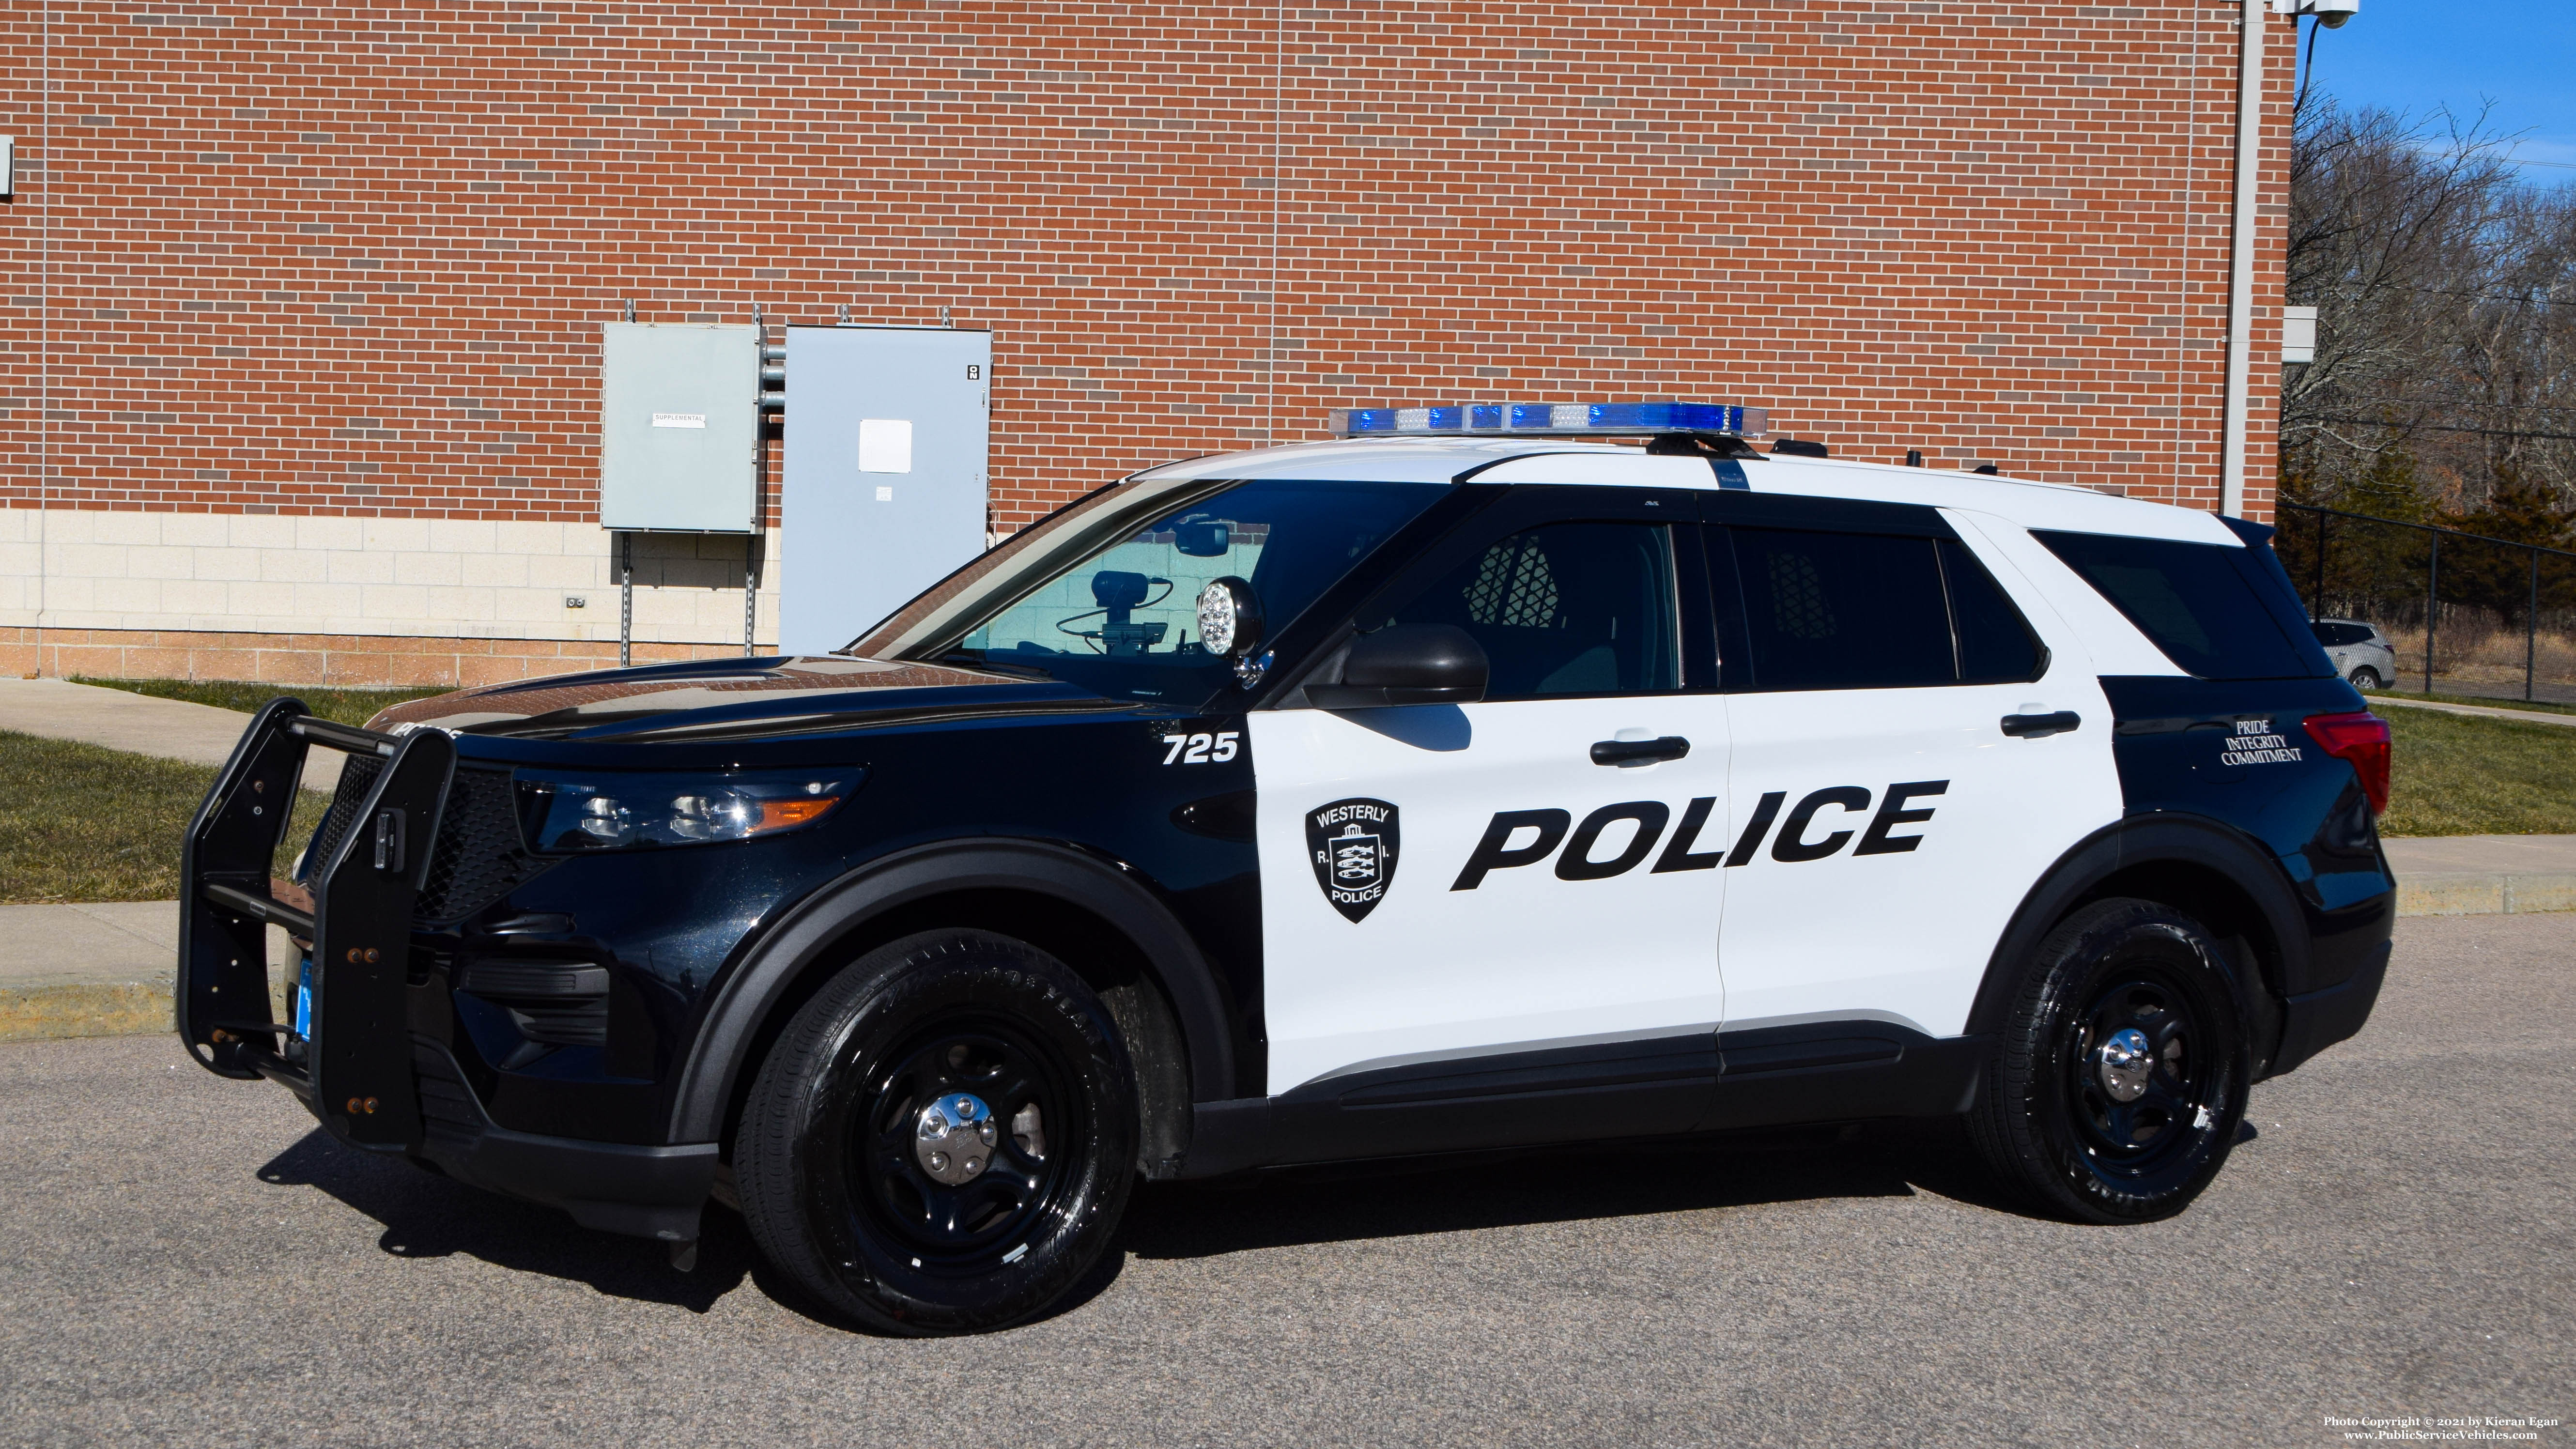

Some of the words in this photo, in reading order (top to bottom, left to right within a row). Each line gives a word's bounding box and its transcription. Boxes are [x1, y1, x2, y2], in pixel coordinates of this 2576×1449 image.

[970, 366, 977, 379] ON
[392, 722, 463, 740] POE
[2236, 720, 2270, 735] PRIDE
[1163, 732, 1239, 765] 725
[2225, 735, 2287, 751] INTEGRITY
[2221, 748, 2303, 766] COMMITMENT
[1316, 805, 1389, 828] WESTERLY
[1449, 779, 1950, 892] POLICE
[1317, 850, 1329, 863] R.
[1332, 885, 1382, 903] POLICE
